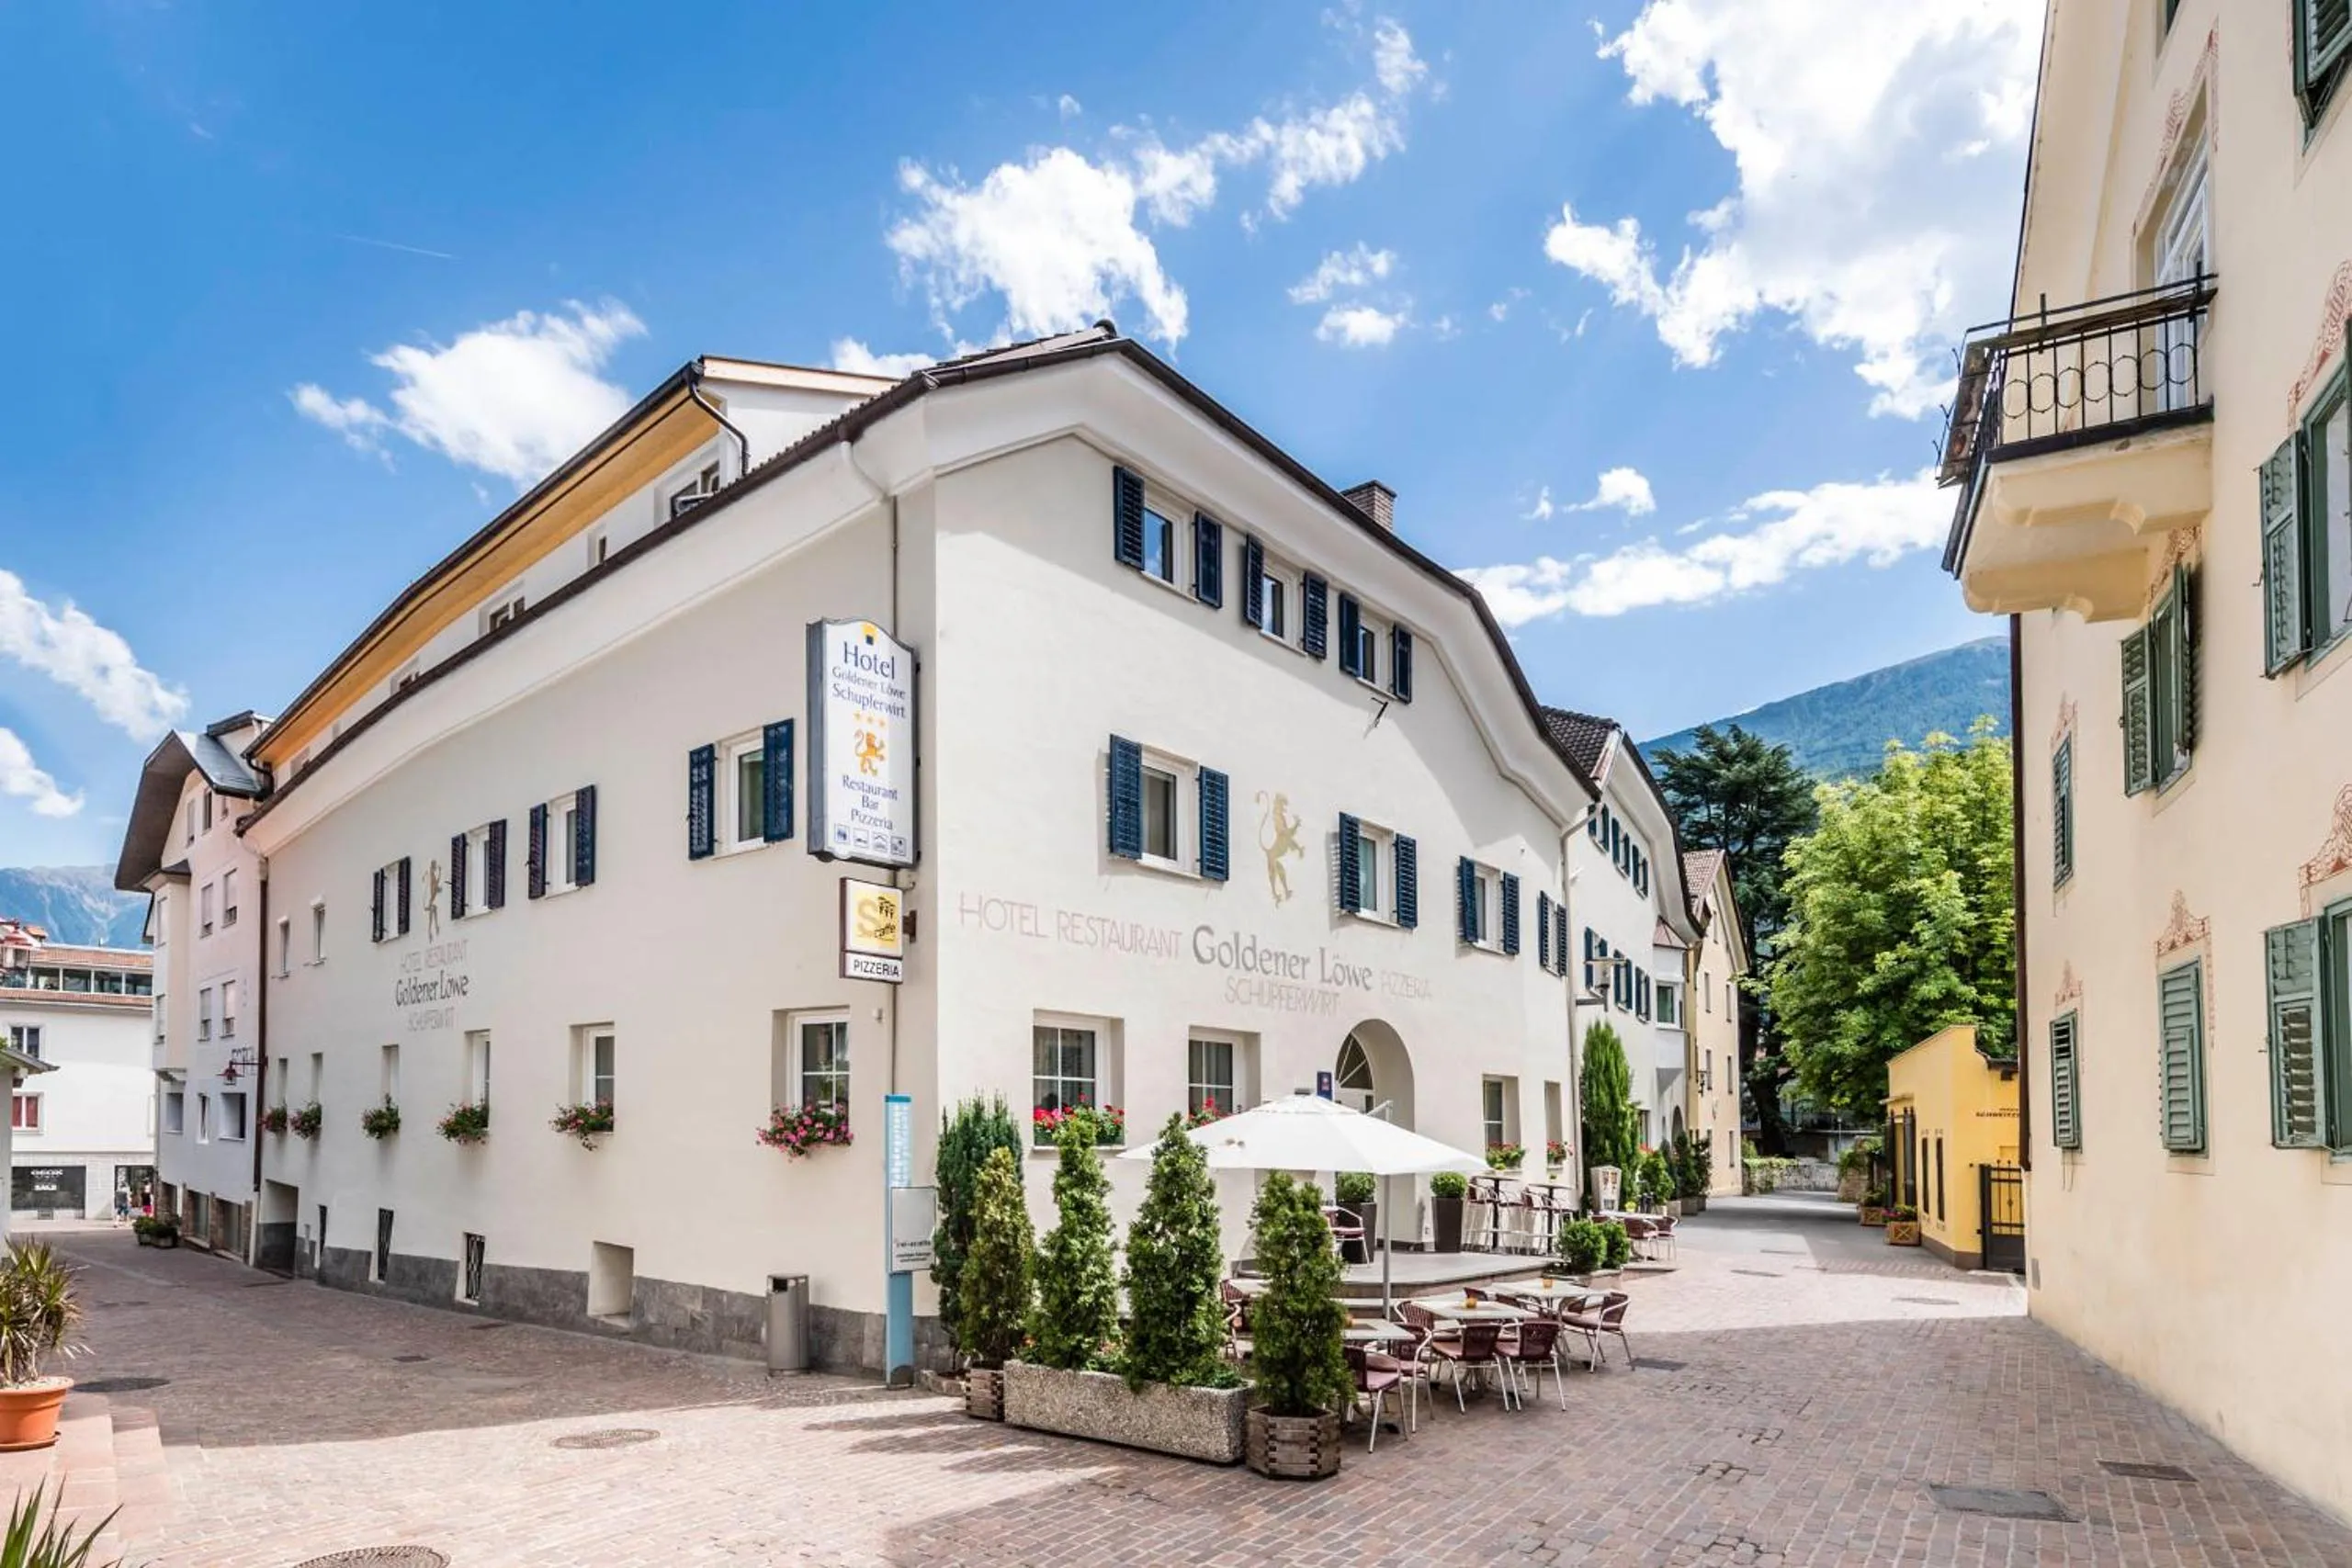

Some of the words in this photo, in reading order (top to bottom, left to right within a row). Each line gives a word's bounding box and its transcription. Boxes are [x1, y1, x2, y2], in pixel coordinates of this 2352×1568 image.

[843, 640, 895, 680] Hotel
[831, 665, 877, 690] Goldener
[842, 774, 898, 801] Restaurant
[862, 795, 879, 809] Bar
[851, 807, 893, 830] Pizzeria
[959, 890, 1048, 939] HOTEL
[1057, 909, 1183, 961] RESTAURANT
[1193, 924, 1311, 980] Goldener
[1318, 946, 1374, 992] Löwe
[853, 958, 899, 977] PIZZERIA
[395, 976, 439, 1007] Goldener
